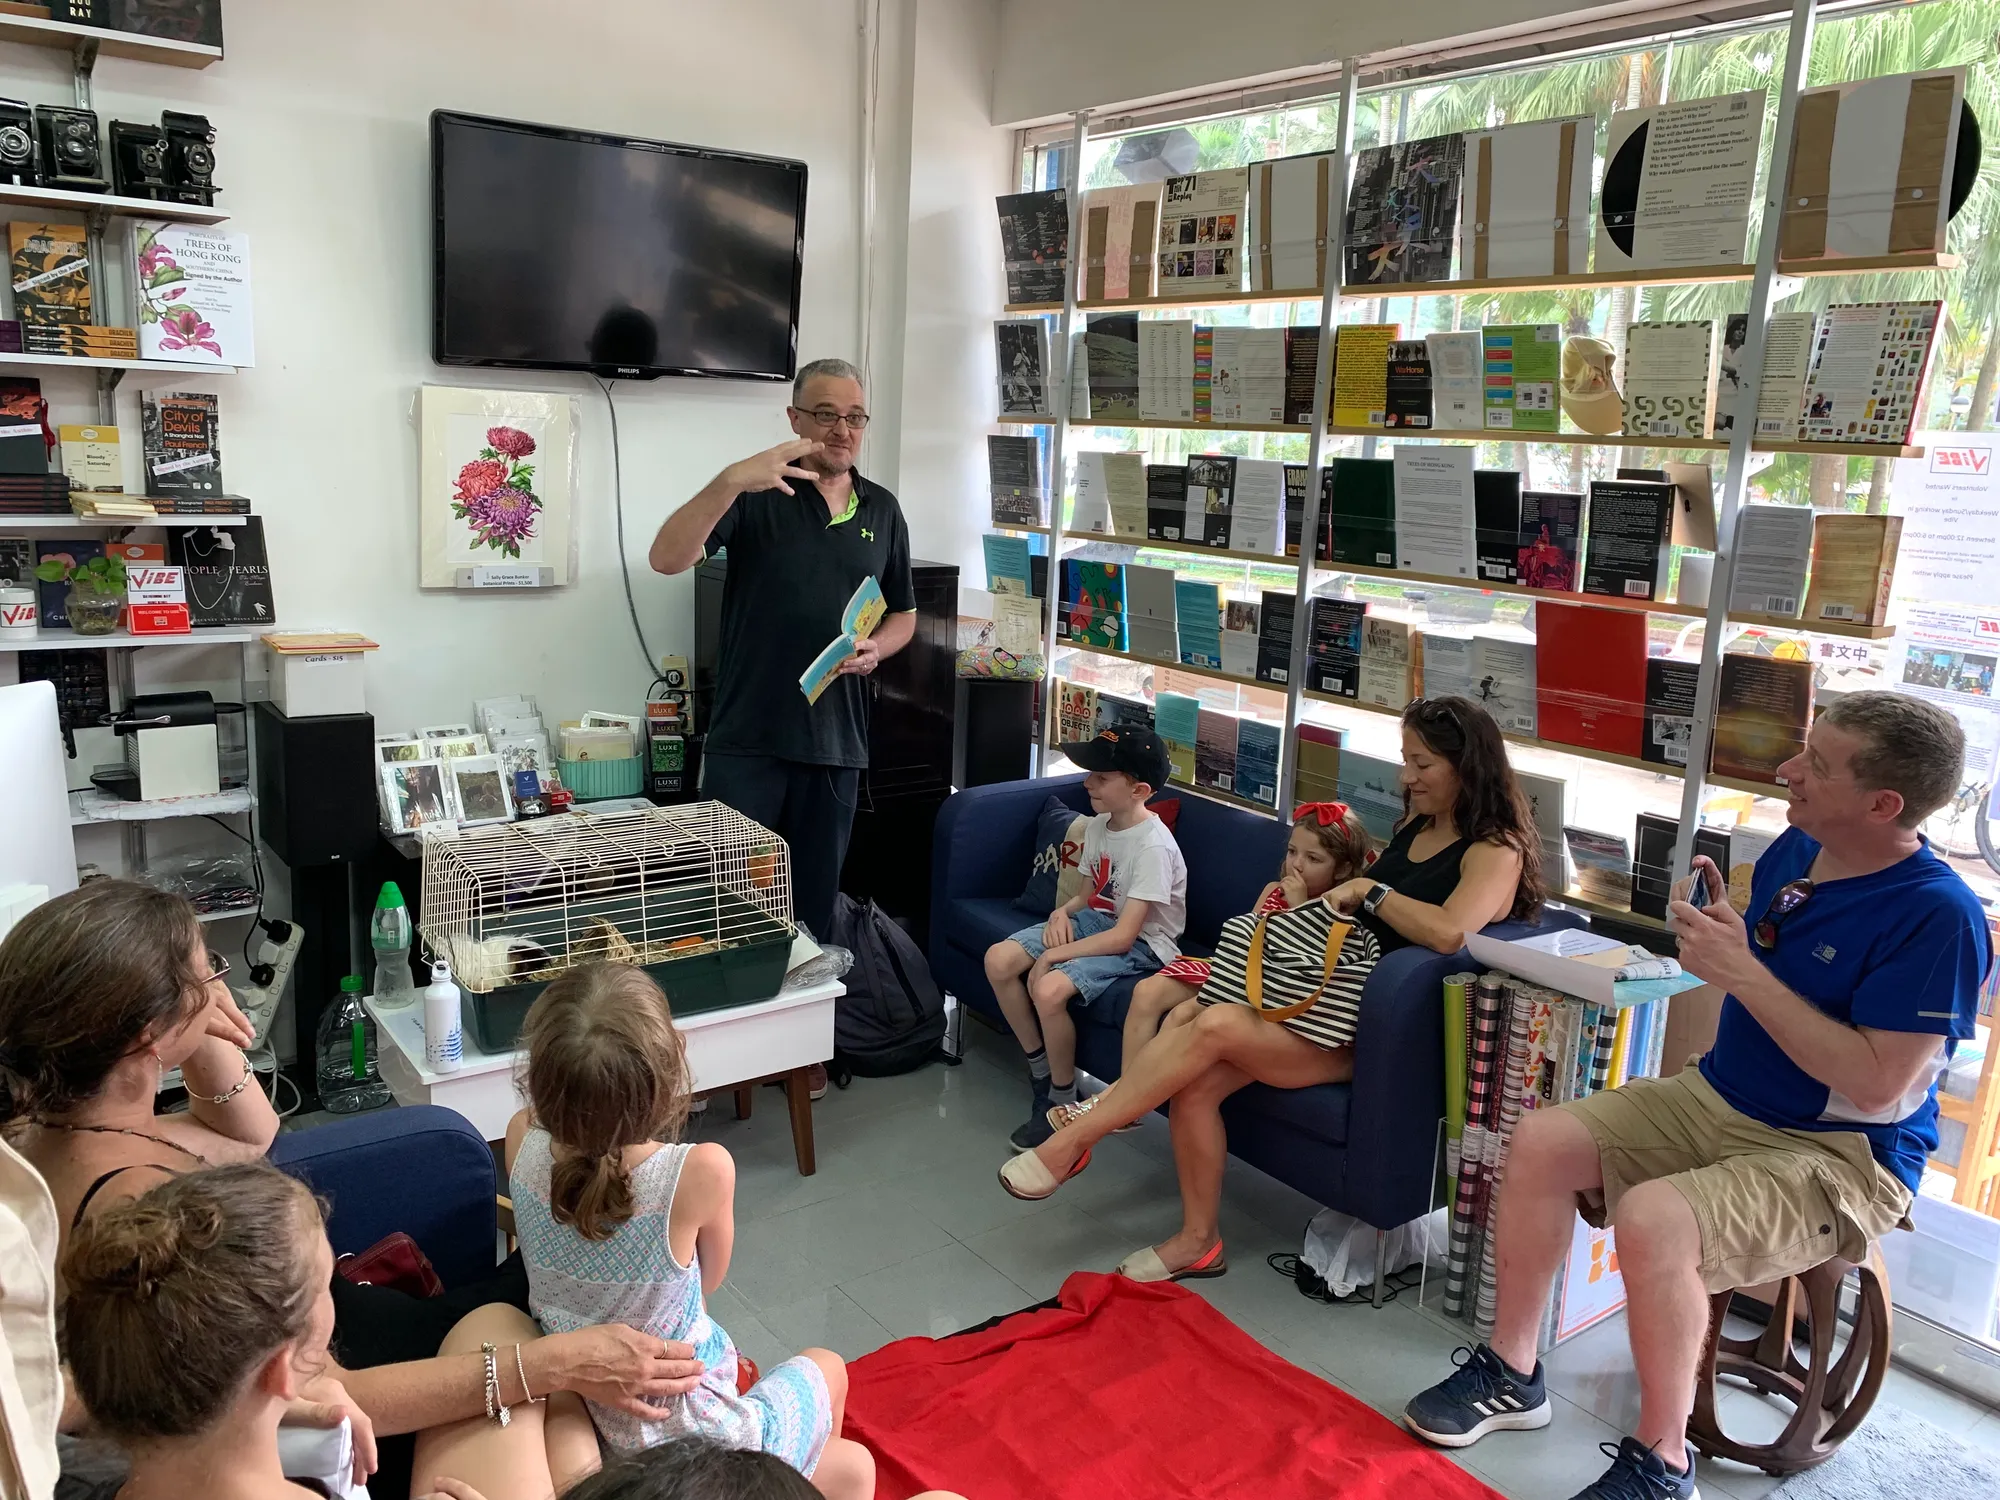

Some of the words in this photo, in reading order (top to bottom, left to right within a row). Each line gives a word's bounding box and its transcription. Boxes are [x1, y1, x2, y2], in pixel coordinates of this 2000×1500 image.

[69, 6, 92, 19] RAY
[1173, 192, 1192, 202] Replay
[189, 232, 218, 240] PORTRAITS
[184, 239, 216, 250] TREES
[218, 243, 232, 252] OF
[176, 248, 208, 259] HONG
[211, 253, 241, 263] KONG
[68, 261, 86, 271] Author
[110, 339, 134, 347] DRACHEN
[163, 410, 189, 422] City
[191, 412, 204, 421] of
[164, 421, 200, 433] Devils
[184, 566, 218, 574] EOPLE
[228, 565, 268, 574] PEARLS
[2, 605, 36, 626] ViB
[305, 655, 327, 663] Cards
[1061, 702, 1091, 719] 1000
[1061, 719, 1090, 732] OBJECTS
